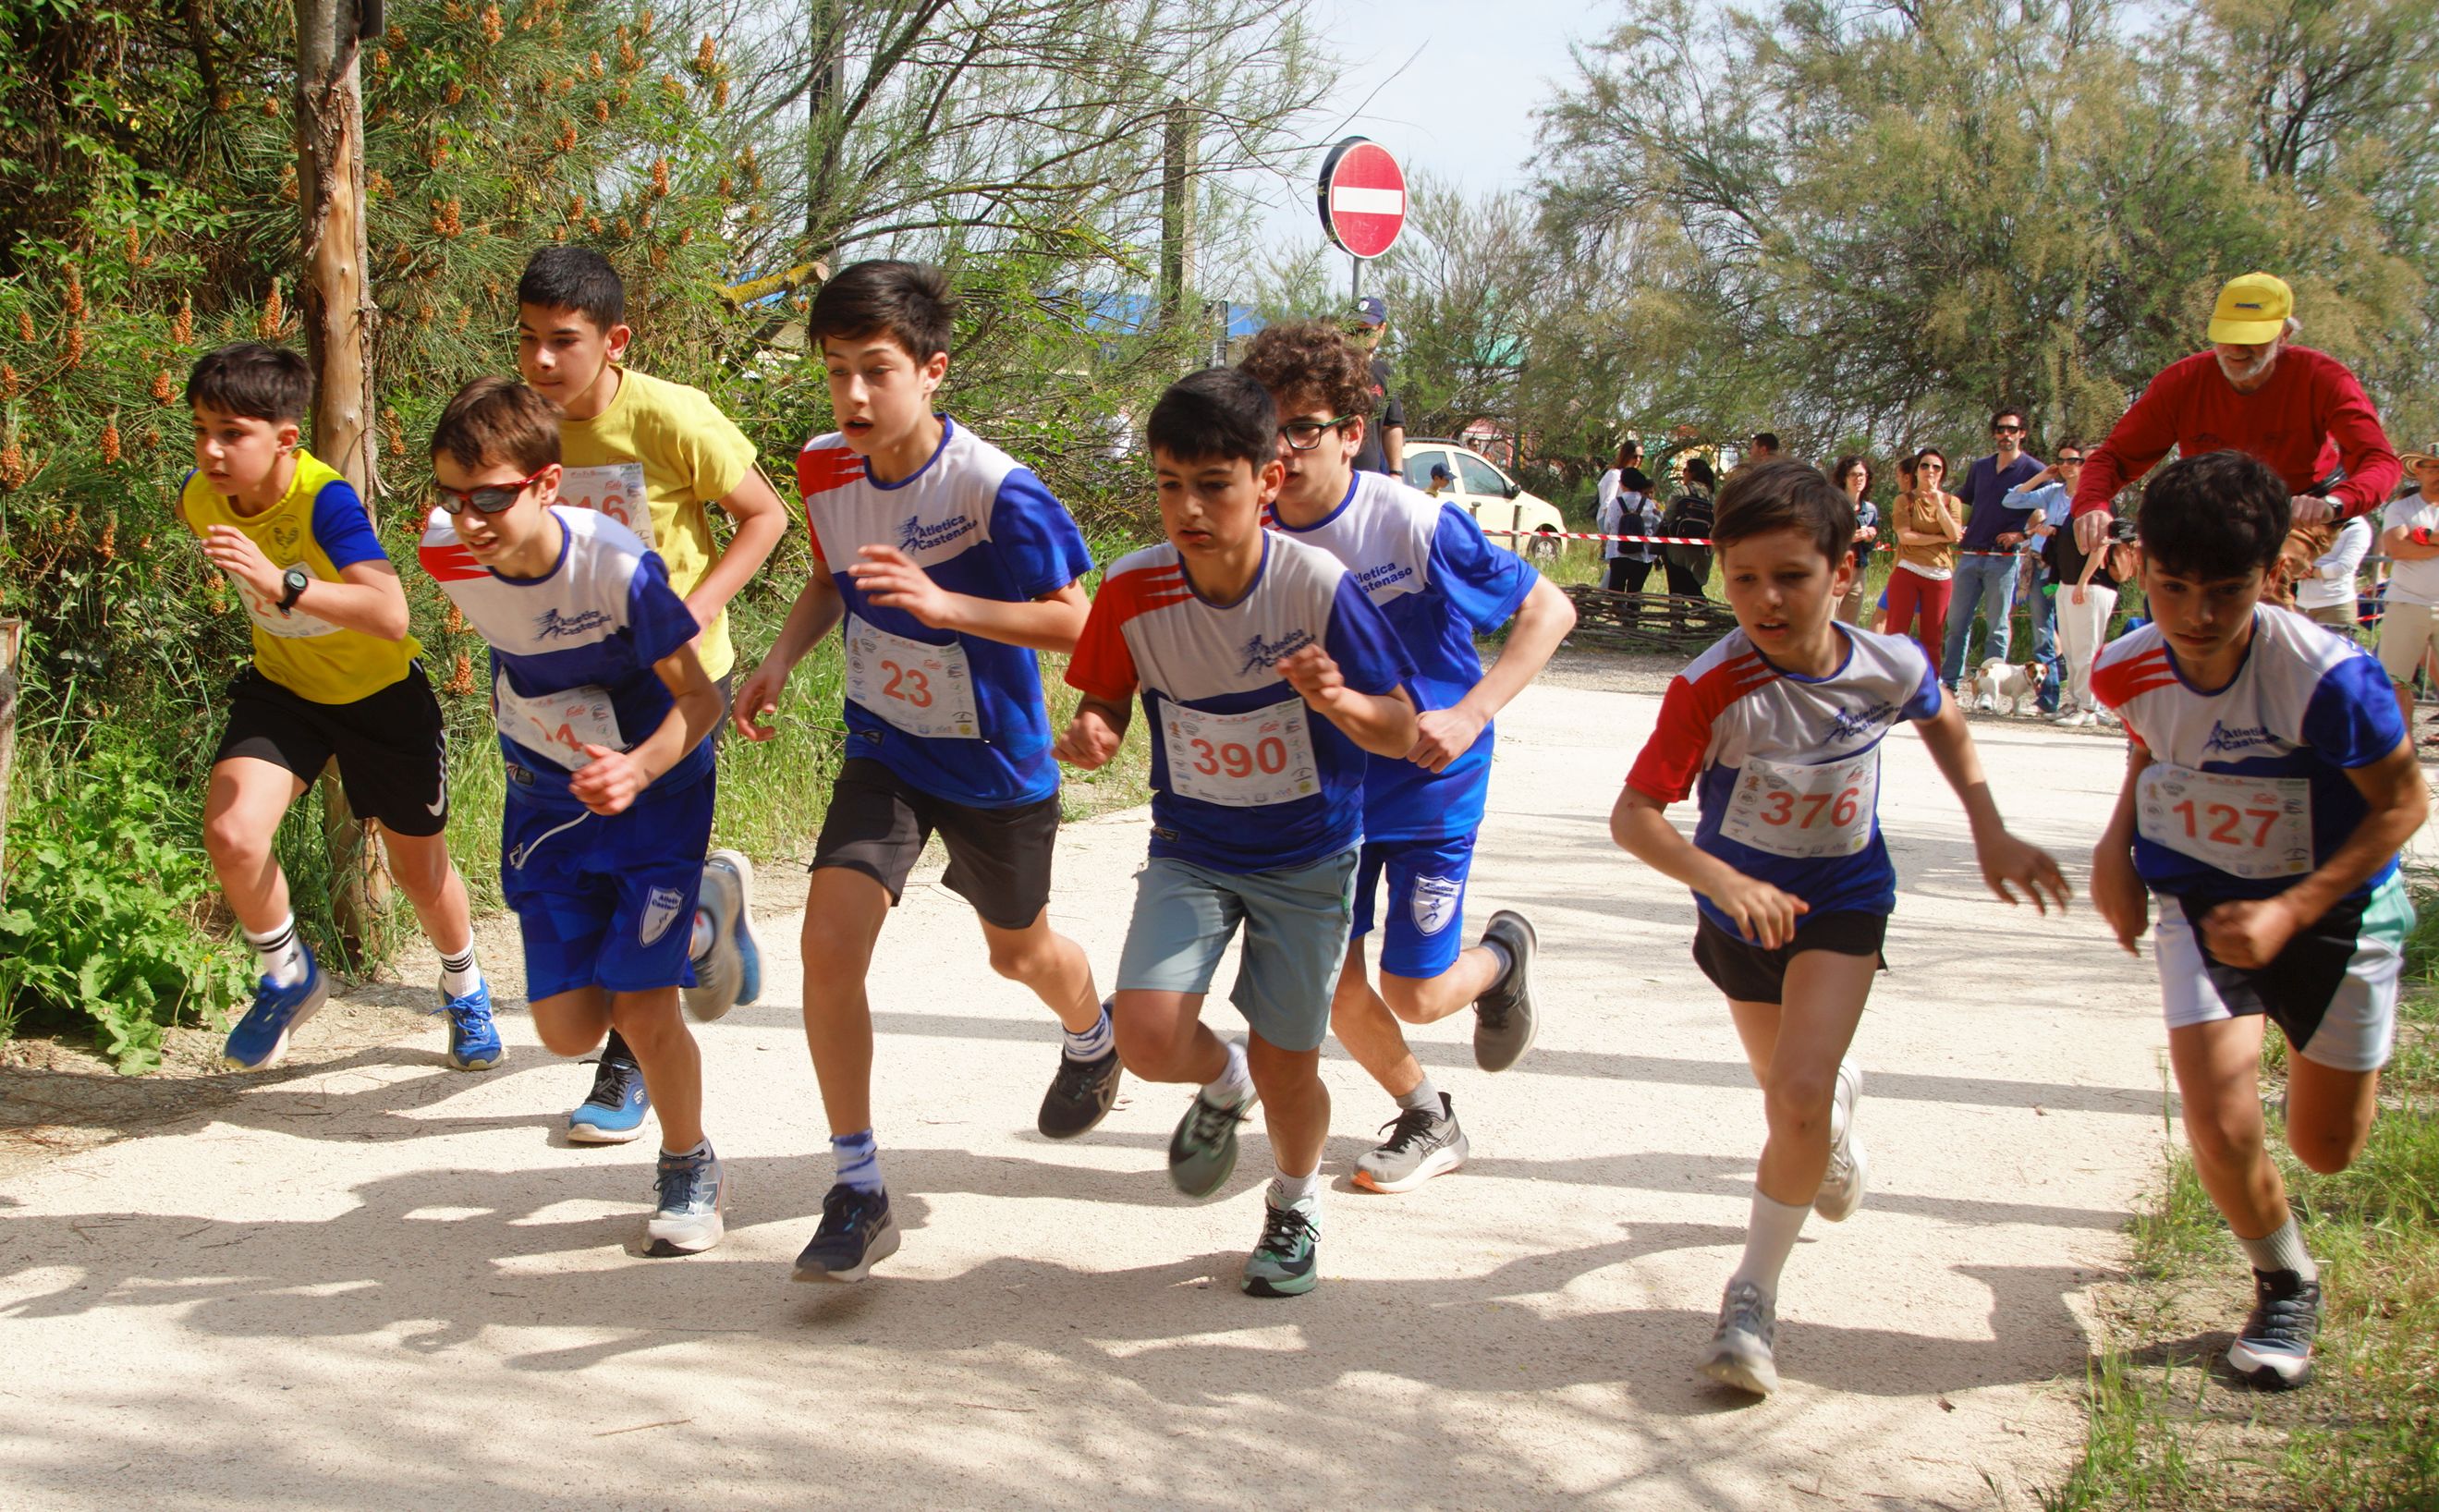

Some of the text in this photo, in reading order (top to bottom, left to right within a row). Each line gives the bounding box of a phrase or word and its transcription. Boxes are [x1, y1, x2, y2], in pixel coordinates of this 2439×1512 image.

[919, 515, 967, 538] Atletica
[1353, 562, 1396, 584] tletica
[1361, 567, 1413, 593] stenaso
[881, 660, 933, 708] 23
[1189, 736, 1287, 779] 390
[1760, 786, 1860, 830] 376
[2173, 799, 2280, 847] 127
